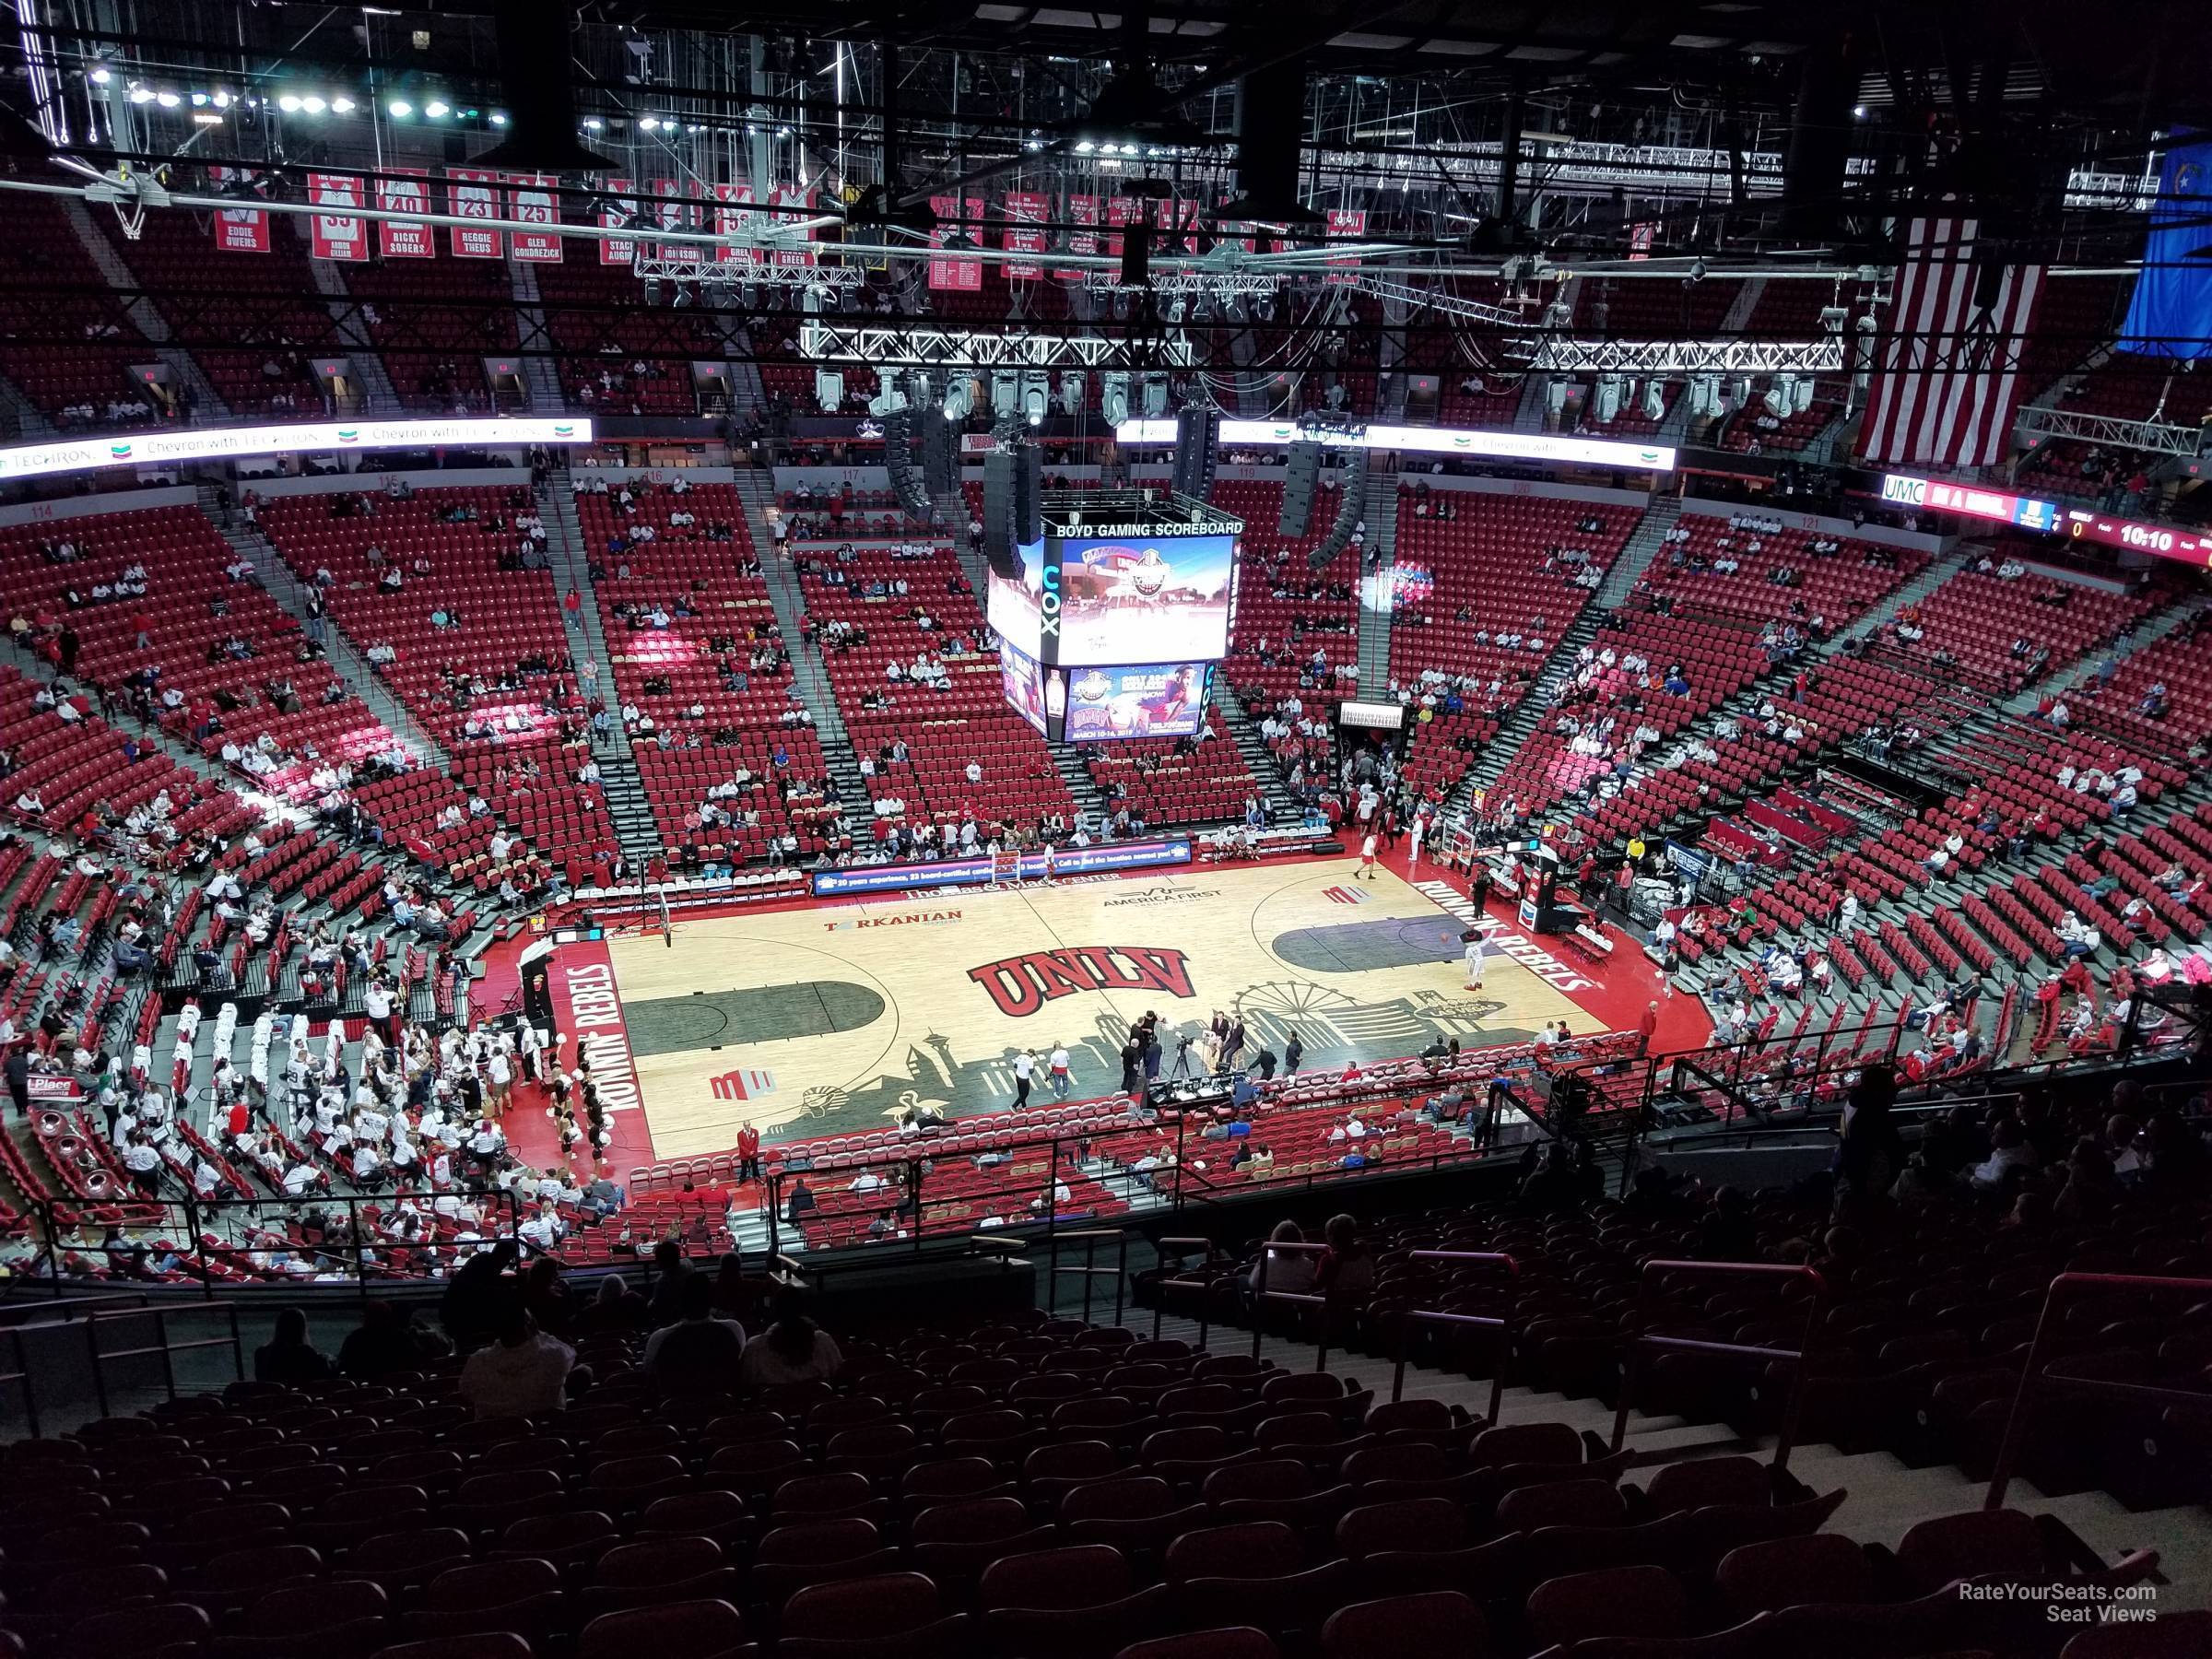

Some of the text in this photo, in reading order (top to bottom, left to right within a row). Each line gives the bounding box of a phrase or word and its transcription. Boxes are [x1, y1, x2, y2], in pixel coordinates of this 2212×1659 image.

[464, 197, 487, 217] 23
[524, 204, 547, 222] 25
[228, 226, 253, 238] EDDIE
[393, 232, 420, 243] RICKY
[462, 232, 492, 243] REGGIE
[226, 237, 257, 249] OWENS
[390, 242, 425, 254] SOBERS
[464, 242, 491, 253] THEUS
[527, 237, 547, 248] GLEN
[514, 247, 560, 258] GONDREZICK
[782, 254, 806, 265] GREEN
[373, 428, 428, 440] Chevron
[431, 427, 460, 439] with
[147, 441, 206, 454] Chevron
[208, 437, 238, 449] with
[842, 470, 859, 480] 117
[1239, 468, 1255, 479] 119
[1885, 477, 1925, 503] UMC
[31, 506, 53, 520] 114
[1056, 522, 1244, 537] BOYD GAMING SCOREBOARD
[1802, 516, 1818, 529] 121
[2073, 522, 2083, 537] 0
[2121, 524, 2173, 552] 10:10
[1041, 565, 1061, 637] COX
[1200, 665, 1216, 725] COX
[849, 877, 868, 887] years
[1107, 854, 1133, 863] location
[1134, 853, 1157, 861] nearest
[1158, 850, 1171, 859] you!
[900, 885, 984, 900] Thoas
[1062, 873, 1124, 886] CENTER
[1103, 889, 1223, 907] AMERICA FIRST
[1489, 934, 1594, 992] REBELS
[966, 946, 1198, 1018] UNLV
[566, 963, 621, 1030] REBELS
[35, 1078, 71, 1090] Place
